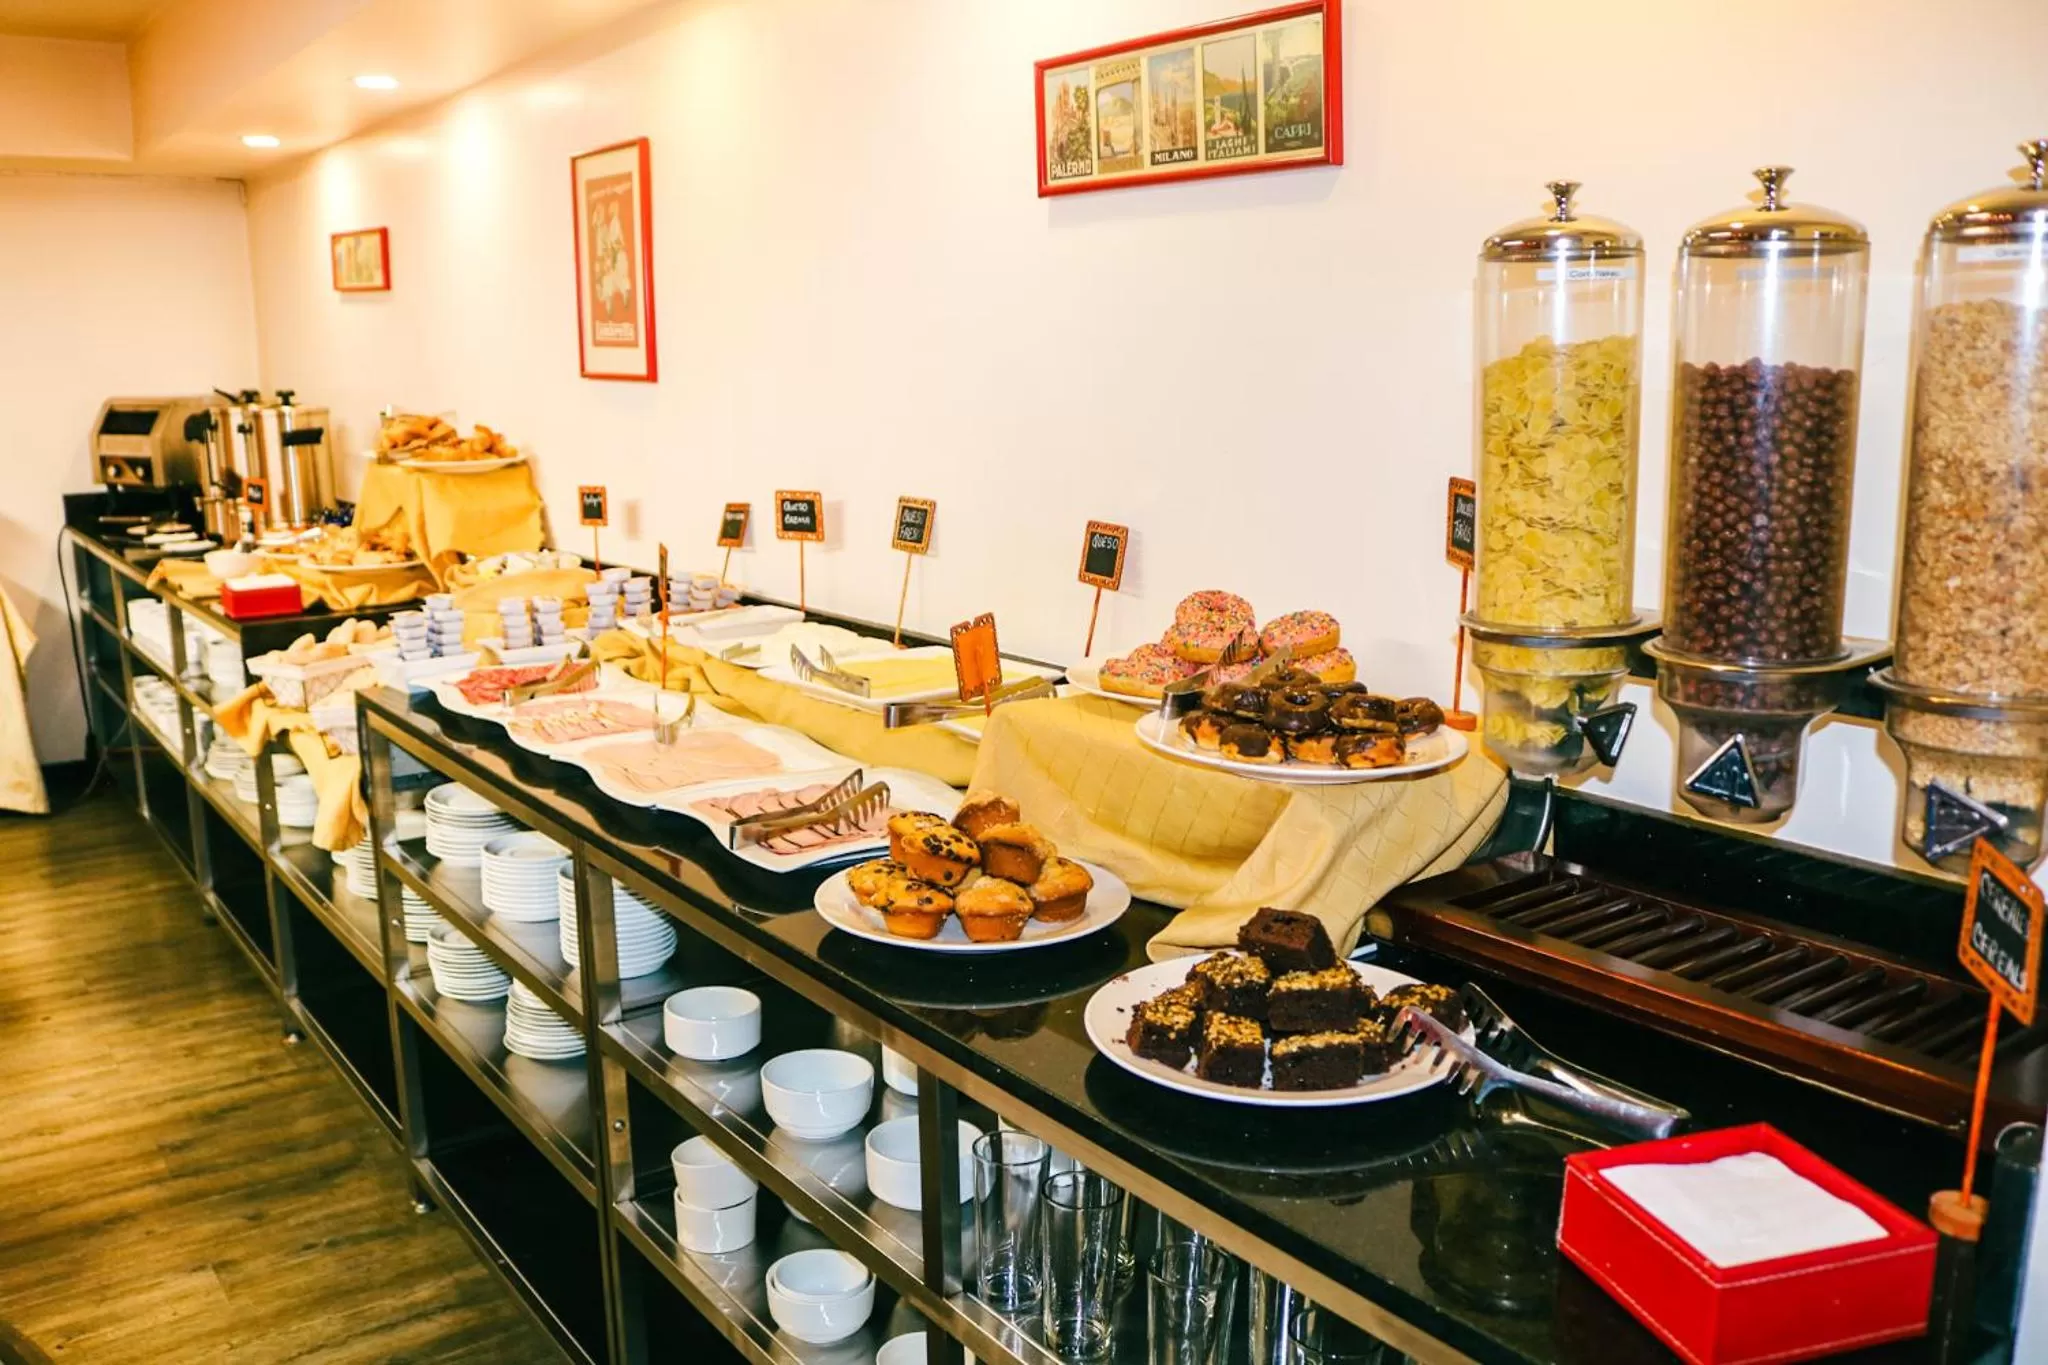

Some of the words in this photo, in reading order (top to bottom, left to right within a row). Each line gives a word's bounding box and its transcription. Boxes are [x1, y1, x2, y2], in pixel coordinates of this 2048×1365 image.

[1275, 122, 1312, 140] CAPRI
[1153, 149, 1194, 164] MILANO
[1207, 144, 1256, 159] ITALIANI
[1050, 159, 1093, 179] PALERMO
[1091, 533, 1119, 550] QUESO
